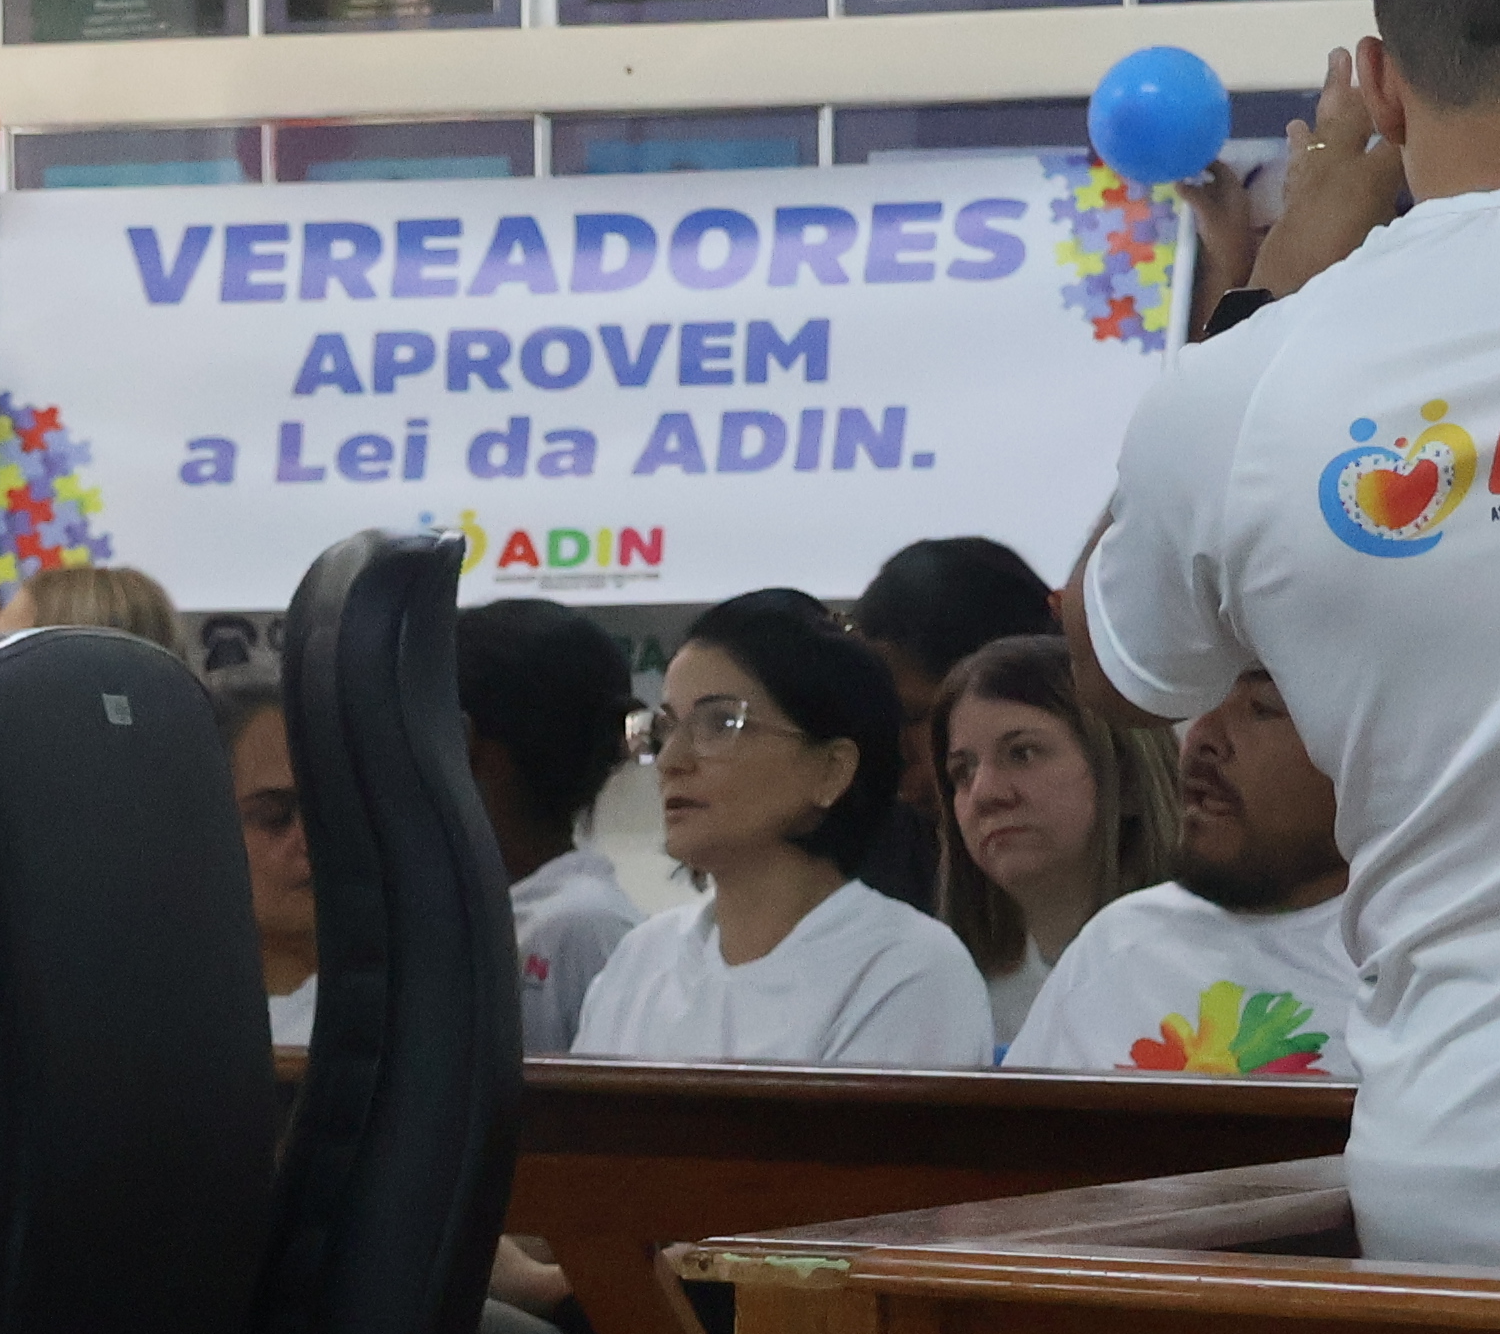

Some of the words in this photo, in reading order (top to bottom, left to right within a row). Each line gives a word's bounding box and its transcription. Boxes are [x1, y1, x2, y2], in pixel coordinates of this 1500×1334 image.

[126, 197, 1028, 306] VEREADORES
[291, 317, 832, 398] APROVEM
[178, 434, 240, 485] a
[274, 417, 430, 483] Lei
[465, 415, 598, 480] da
[631, 405, 937, 476] ADIN.
[498, 526, 664, 569] ADIN
